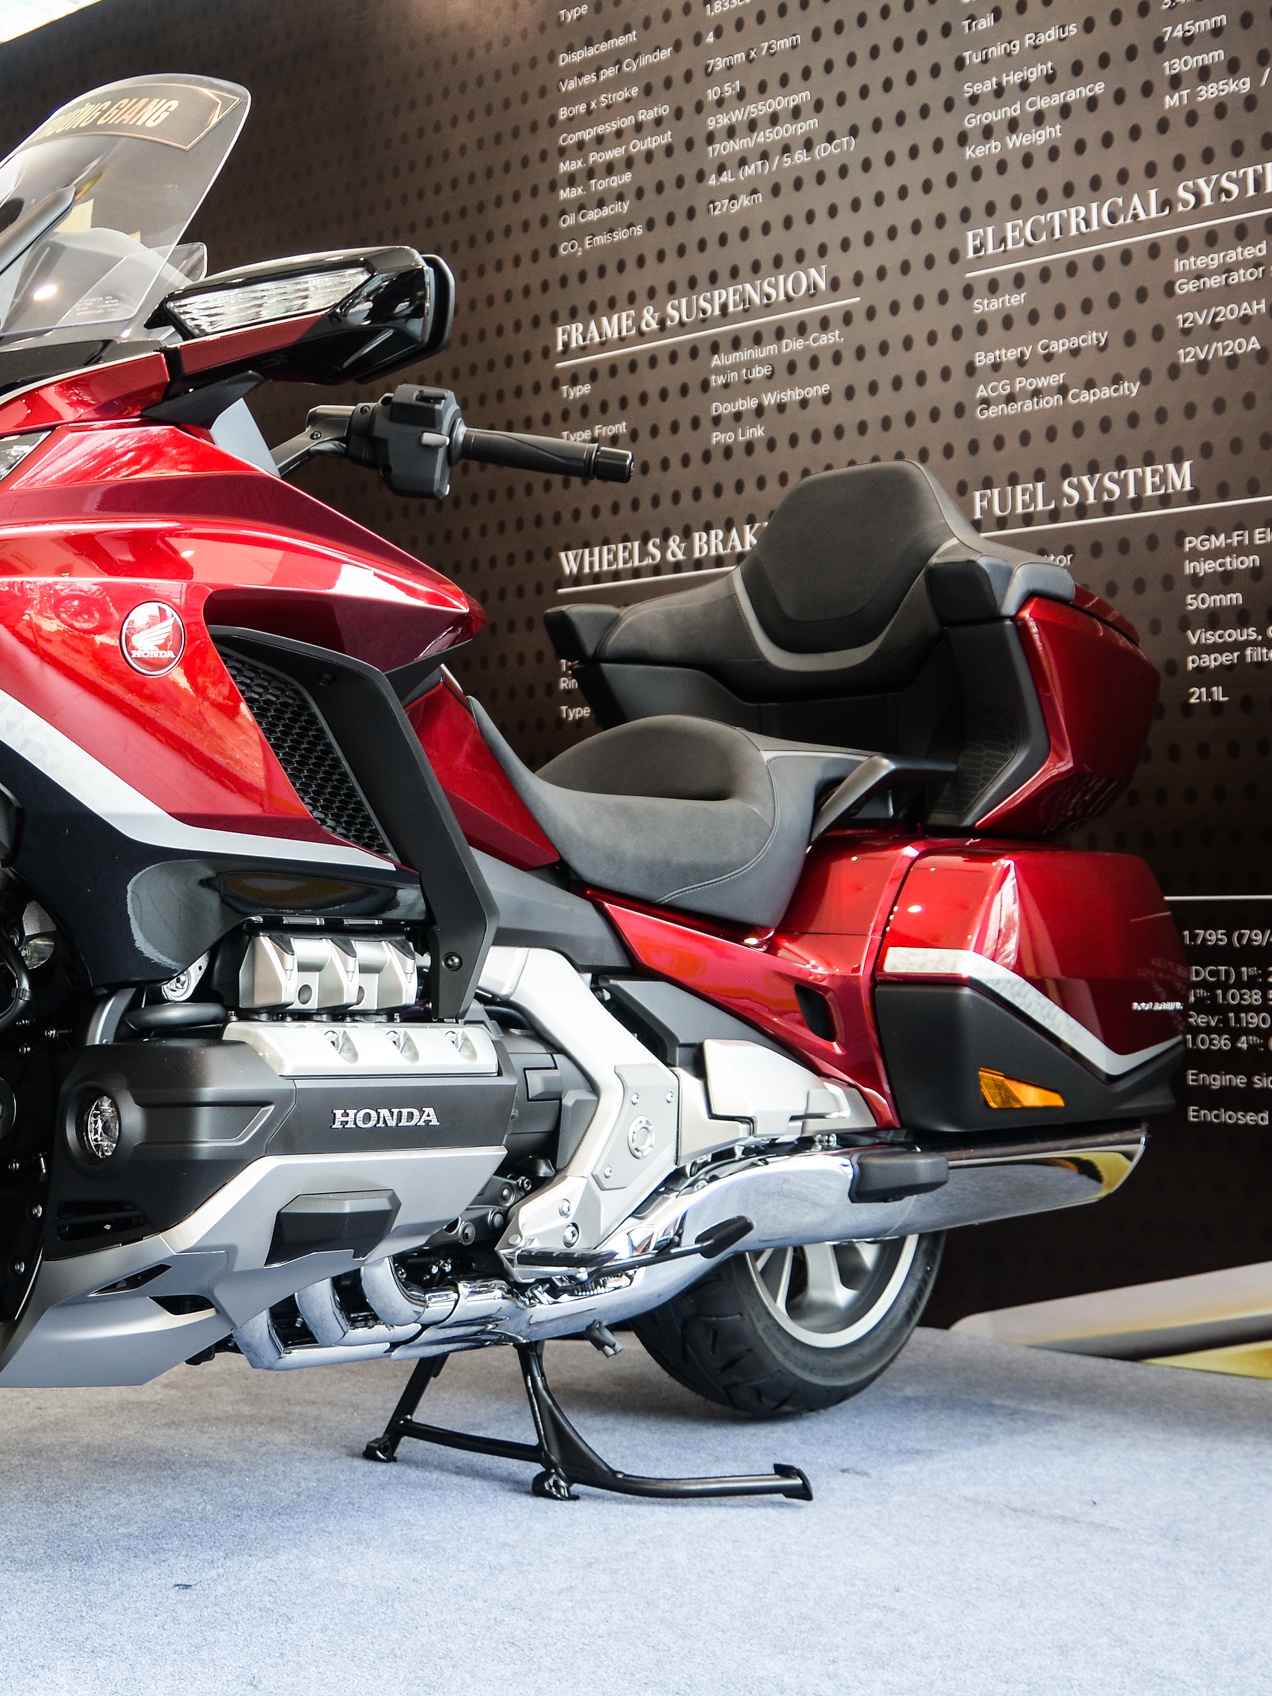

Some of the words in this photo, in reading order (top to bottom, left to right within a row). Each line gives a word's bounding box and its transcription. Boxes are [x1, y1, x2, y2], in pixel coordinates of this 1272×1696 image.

[559, 2, 589, 23] Type
[962, 13, 994, 34] Trail
[706, 31, 715, 44] 4
[1162, 13, 1227, 43] 745mm
[559, 29, 637, 66] Displacement
[706, 52, 746, 74] 73mm
[749, 48, 757, 59] x
[760, 33, 802, 57] 73mm
[963, 39, 1020, 65] Turning
[1025, 22, 1078, 47] Radius
[559, 73, 596, 94] Valves
[599, 65, 620, 82] per
[623, 45, 672, 74] Cylinder
[1163, 49, 1225, 76] 130mm
[707, 80, 741, 101] 10.5:1
[964, 79, 998, 97] Seat
[1002, 61, 1054, 87] Height
[1165, 89, 1192, 110] MT
[1196, 75, 1250, 102] 385kg
[96, 98, 180, 128] GIANG
[560, 101, 586, 120] Bore
[589, 99, 597, 109] x
[600, 85, 639, 108] Stroke
[707, 89, 811, 130] 93kW/5500rpm
[966, 103, 1022, 128] Ground
[1025, 80, 1105, 111] Clearance
[560, 113, 635, 146] Compression
[638, 103, 670, 123] Ratio
[708, 117, 819, 158] 170Nm/4500rpm
[560, 157, 586, 173] Max.
[589, 144, 626, 166] Power
[630, 130, 672, 154] Output
[966, 139, 1001, 160] Kerb
[1006, 124, 1062, 149] Weight
[708, 169, 735, 187] 4.4L
[739, 160, 769, 180] (MT)
[772, 156, 779, 172] /
[783, 147, 812, 167] 5.6L
[816, 135, 856, 162] (DCT)
[560, 184, 586, 200] Max.
[590, 170, 632, 193] Torque
[560, 212, 576, 228] Oil
[579, 199, 629, 223] Capacity
[708, 191, 763, 216] 127g/km
[585, 224, 643, 249] Emissions
[966, 188, 1169, 259] ELECTRICAL
[1174, 240, 1267, 273] Integrated
[1175, 265, 1265, 296] Generator
[556, 309, 636, 352] FRAME
[640, 305, 660, 331] &
[665, 264, 828, 327] SUSPENSION
[973, 291, 1027, 313] Starter
[1176, 298, 1266, 329] 12V/20AH
[712, 342, 778, 368] Aluminium
[782, 328, 845, 354] Die-Cast,
[975, 343, 1032, 367] Battery
[1037, 329, 1109, 355] Capacity
[1177, 335, 1261, 365] 12V/120A
[712, 369, 738, 386] twin
[742, 363, 773, 381] tube
[976, 378, 1010, 399] ACG
[1015, 371, 1065, 394] Power
[562, 382, 591, 399] Type
[712, 395, 759, 416] Double
[763, 382, 830, 408] Wishbone
[977, 392, 1063, 419] Generation
[1068, 380, 1141, 404] Capacity
[562, 426, 592, 442] Type
[595, 421, 627, 441] Front
[712, 430, 735, 445] Pro
[738, 424, 765, 441] Link
[973, 481, 1055, 520] FUEL
[1062, 460, 1194, 508] SYSTEM
[559, 537, 661, 577] WHEELS
[666, 536, 687, 562] &
[693, 521, 769, 558] BRAK
[1184, 528, 1249, 553] PGM-FI
[1184, 553, 1260, 576] Injection
[1186, 592, 1242, 611] 50mm
[1187, 626, 1262, 645] Viscous,
[130, 649, 176, 658] HONDA
[1187, 650, 1240, 671] paper
[1189, 685, 1229, 704] 21.1L
[560, 705, 591, 721] Type
[1182, 929, 1228, 946] 1.795
[1215, 989, 1262, 1005] 1.038
[1227, 1012, 1271, 1029] 1.190
[1185, 1033, 1232, 1051] 1.036
[1186, 1069, 1248, 1090] Engine
[330, 1107, 441, 1129] HONDA
[1187, 1105, 1270, 1126] Enclosed
